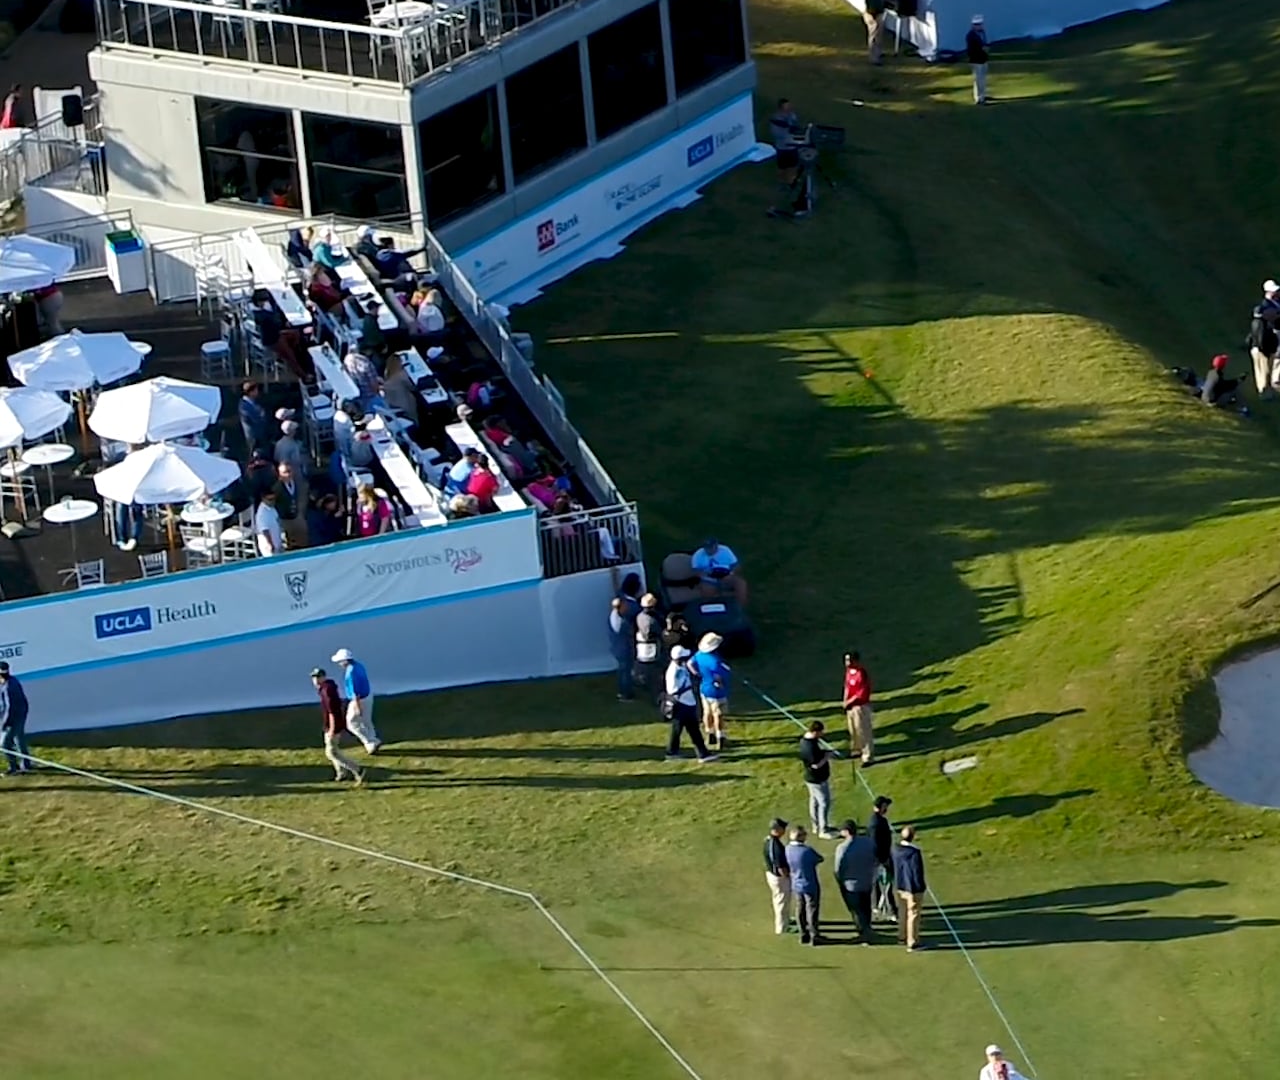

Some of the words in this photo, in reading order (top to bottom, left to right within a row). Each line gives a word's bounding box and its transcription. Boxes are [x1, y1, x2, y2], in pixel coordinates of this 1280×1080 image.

[556, 214, 579, 236] Bank
[102, 614, 145, 633] UCLA
[156, 601, 217, 625] Health
